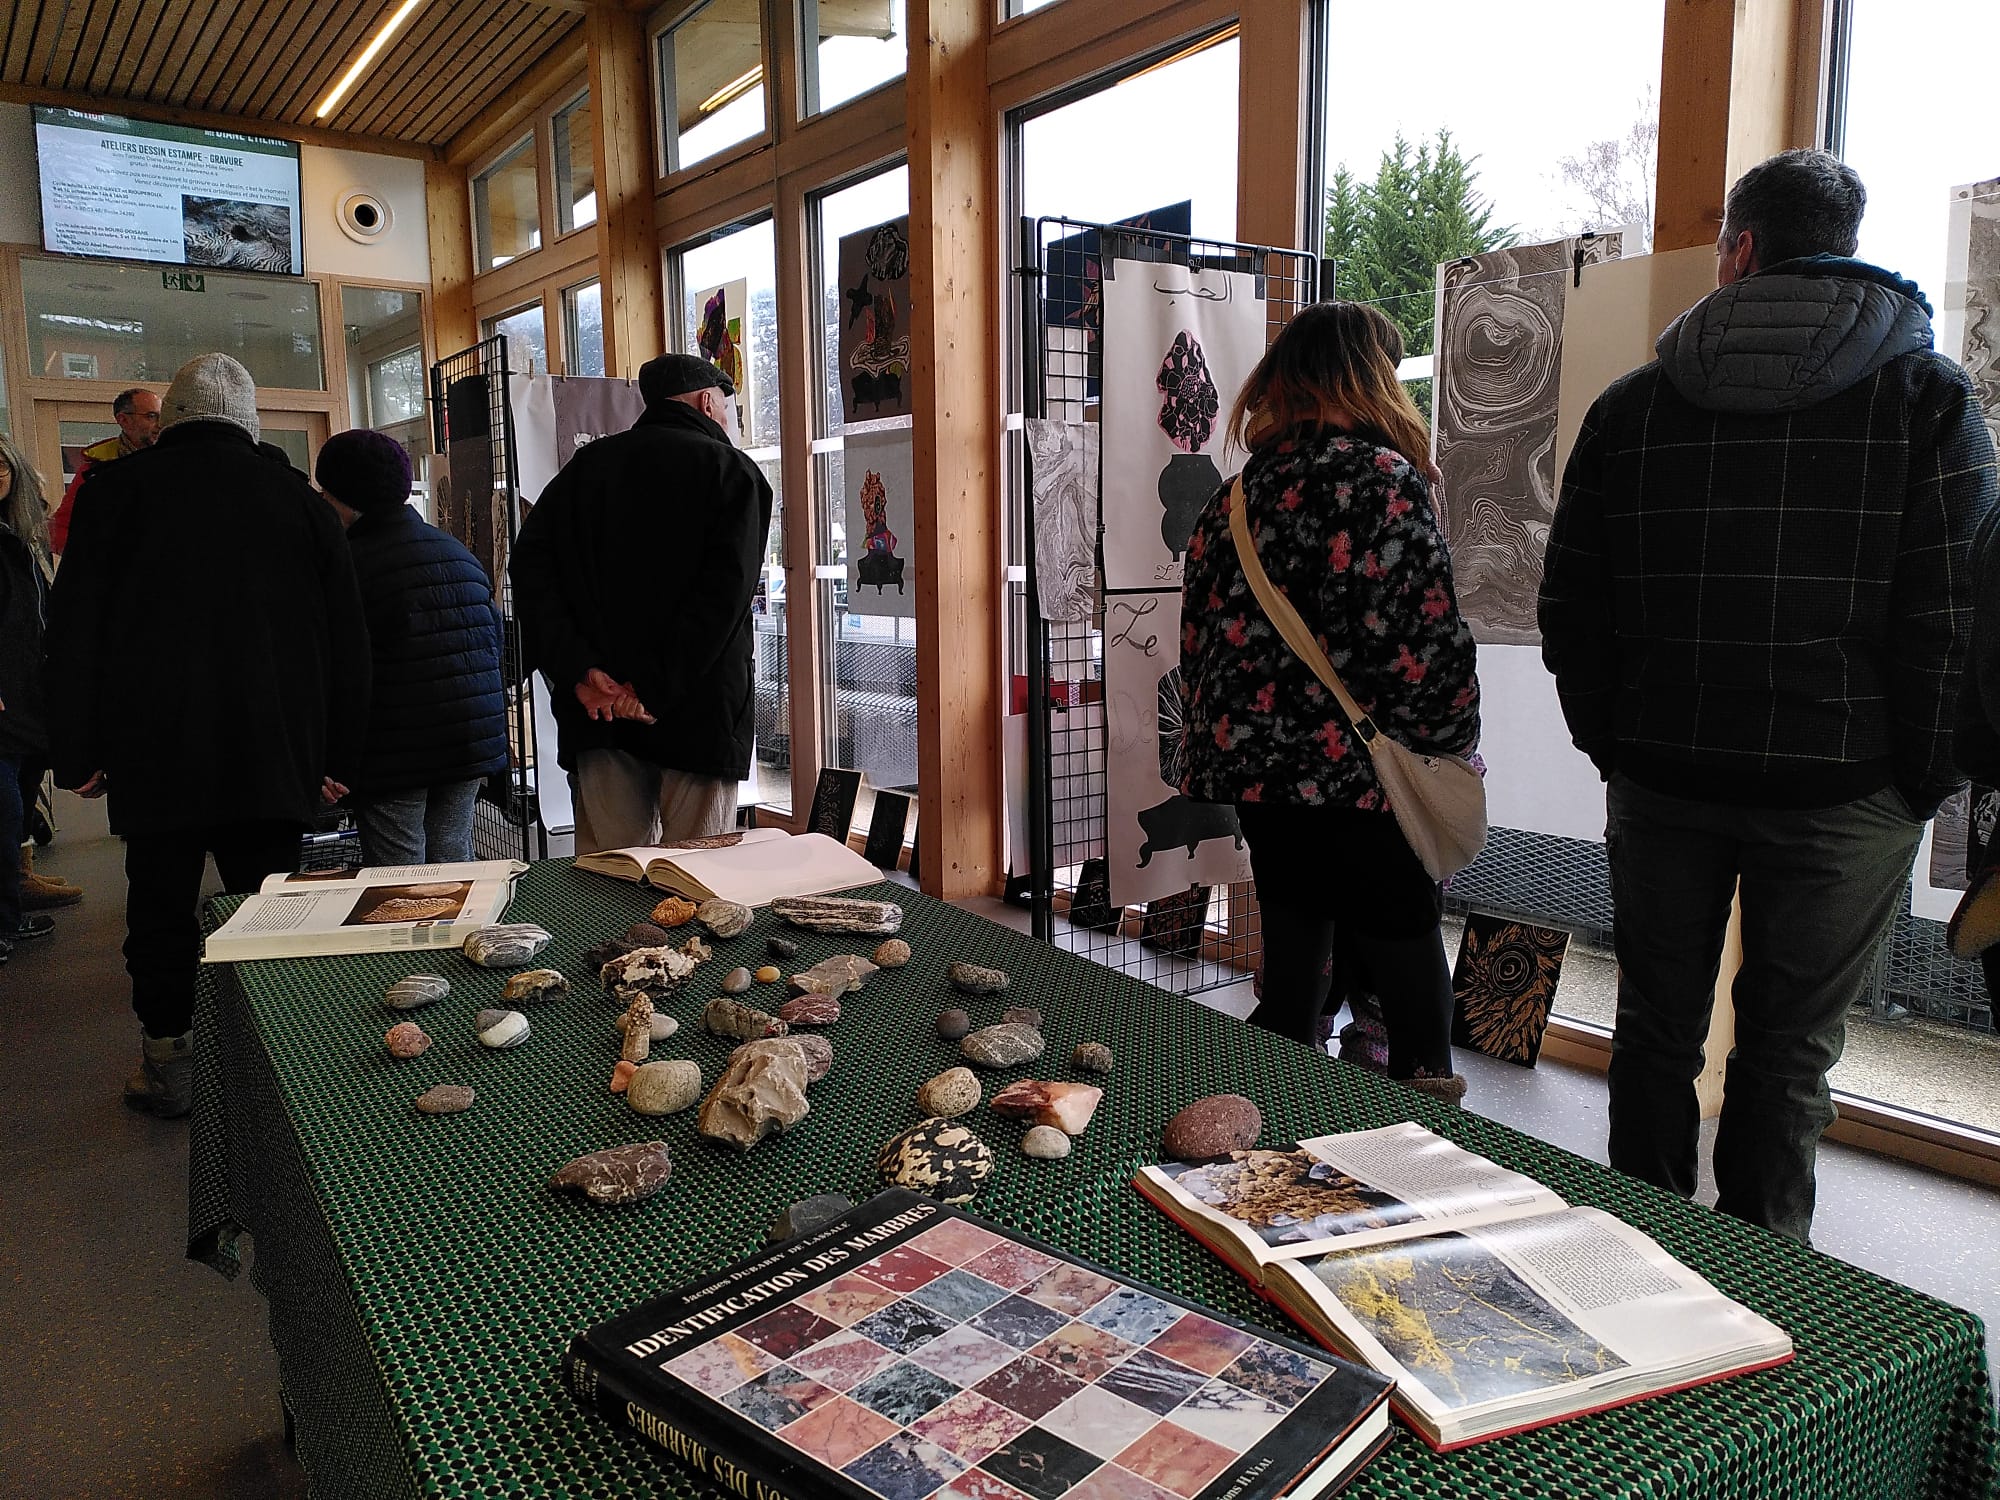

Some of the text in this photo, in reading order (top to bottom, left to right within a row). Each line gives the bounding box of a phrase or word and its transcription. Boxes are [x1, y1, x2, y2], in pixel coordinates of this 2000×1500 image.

[101, 140, 136, 154] ATELIERS
[138, 144, 166, 157] DESSIN
[168, 148, 202, 162] ESTAMPE
[210, 154, 244, 166] GRAVURE
[1111, 598, 1159, 658] Le
[624, 1202, 937, 1360] IDENTIFICATION DES MARBRES
[681, 1278, 731, 1304] Jacques
[626, 1401, 707, 1473] MARBRES
[713, 1455, 748, 1499] DES
